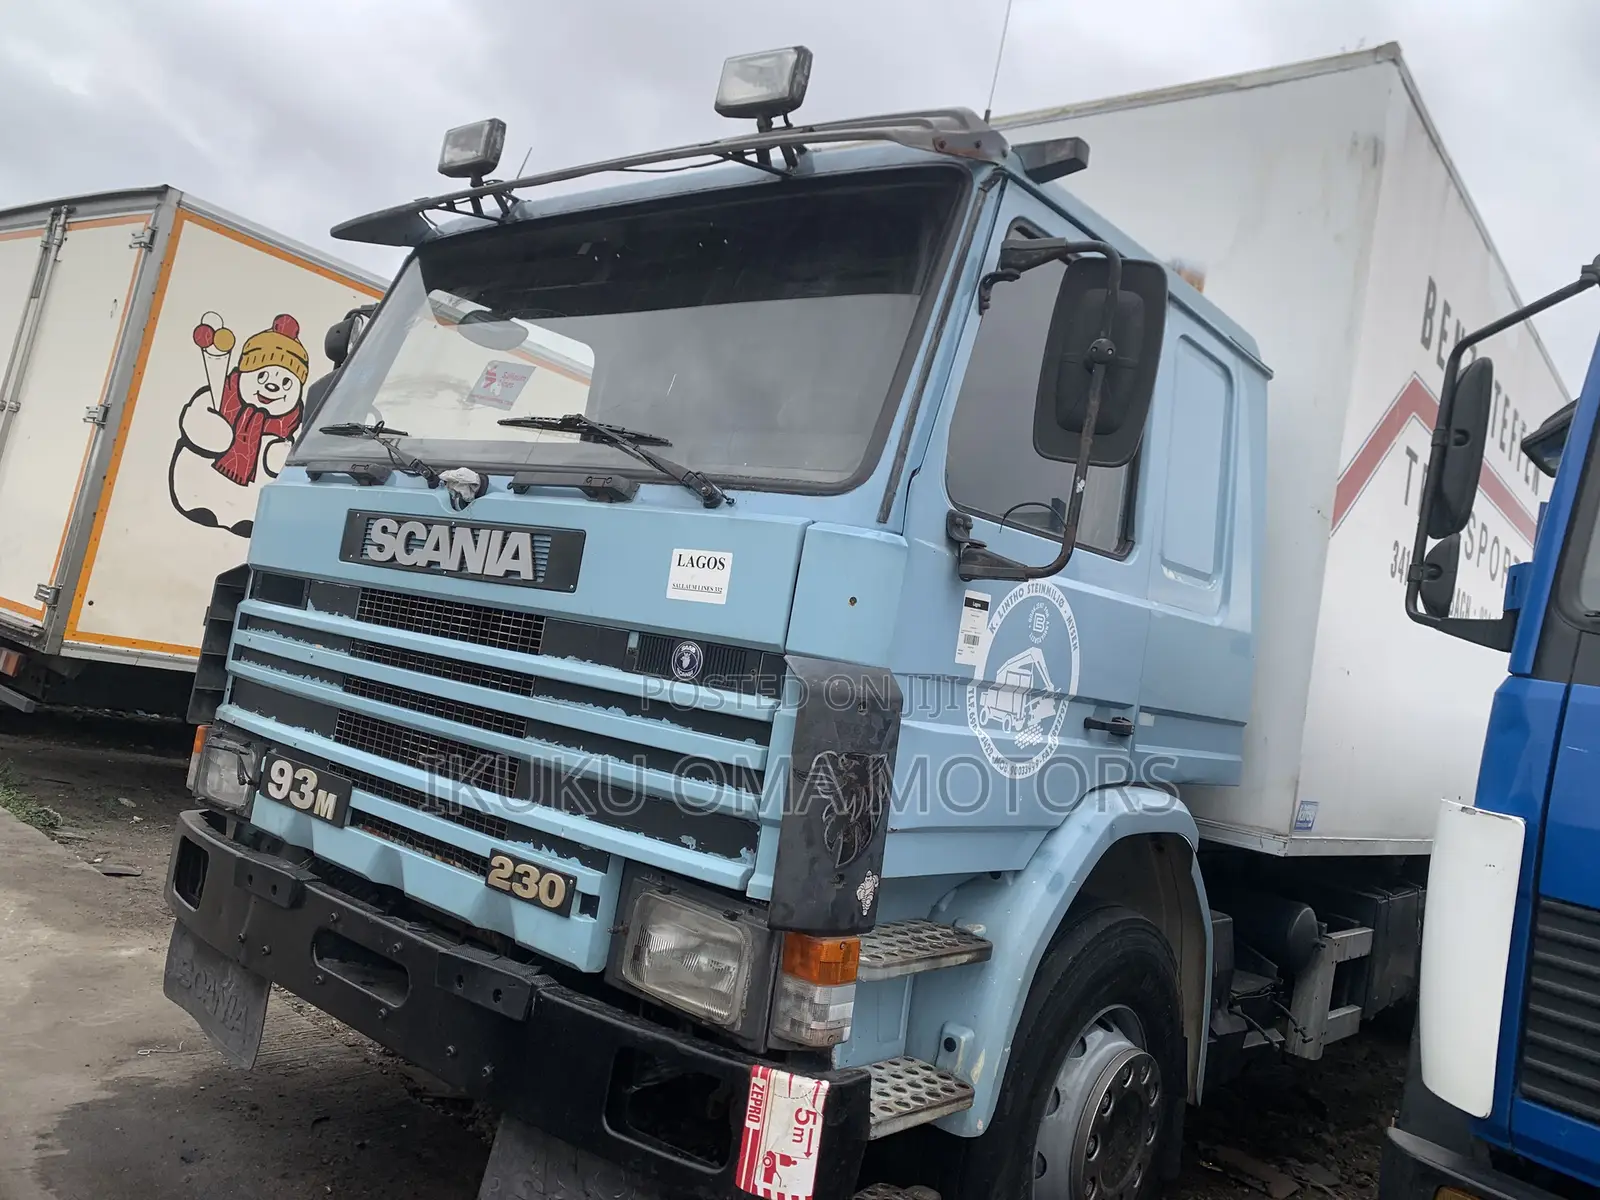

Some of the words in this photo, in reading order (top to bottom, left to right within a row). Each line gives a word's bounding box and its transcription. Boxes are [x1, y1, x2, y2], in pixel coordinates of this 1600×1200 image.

[366, 517, 536, 582] SCANIA
[677, 553, 726, 572] LAGOS
[487, 855, 566, 908] 230
[746, 1083, 766, 1124] ZEPRO
